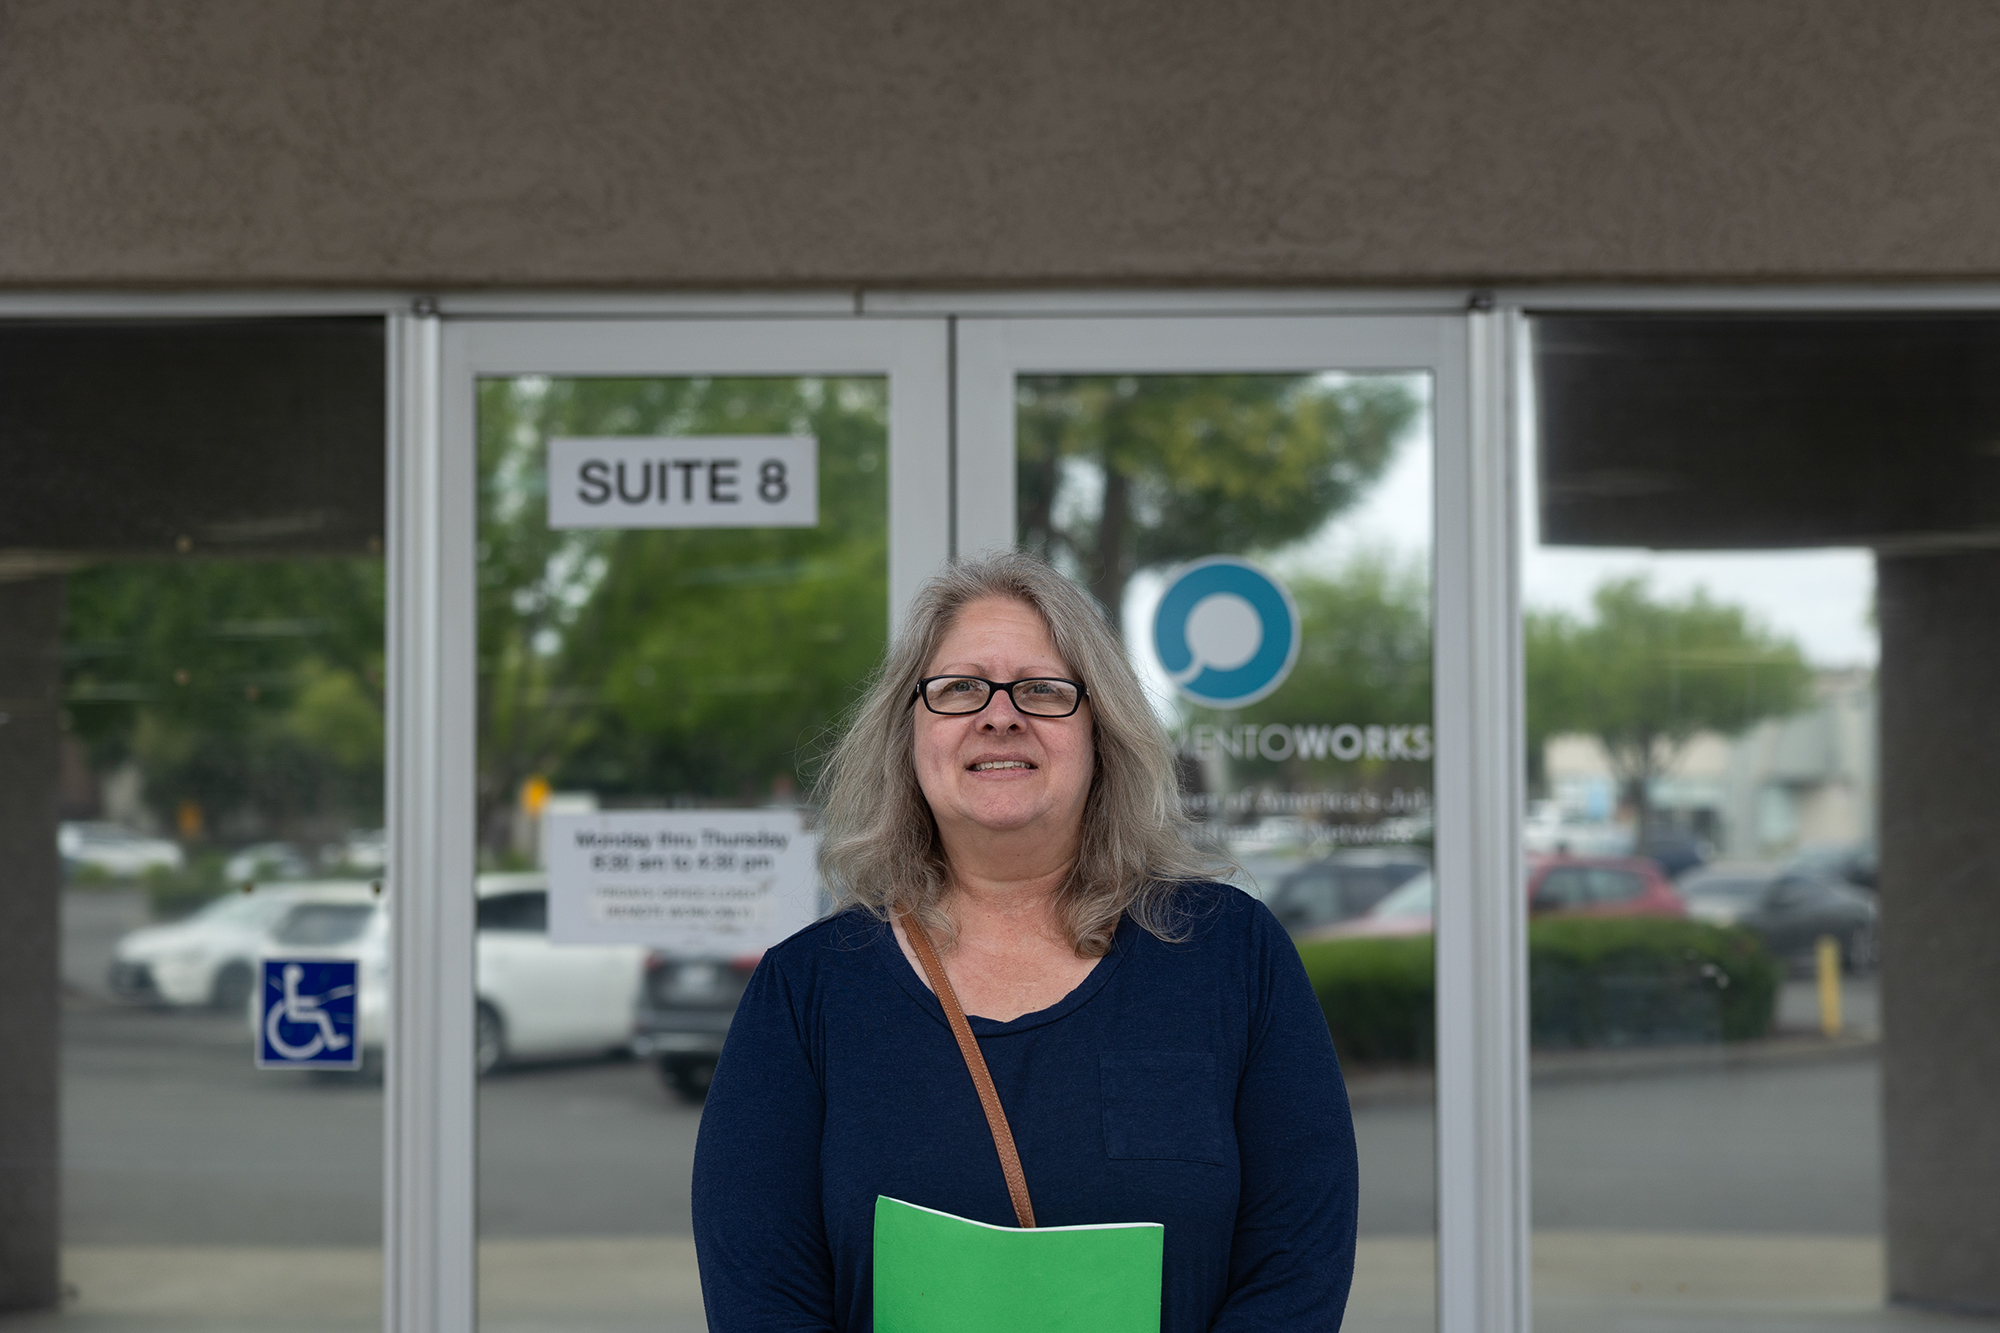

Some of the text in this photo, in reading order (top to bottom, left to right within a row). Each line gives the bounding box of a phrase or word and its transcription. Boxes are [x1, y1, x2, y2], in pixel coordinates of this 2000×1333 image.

[578, 458, 789, 505] SUITE 8
[575, 828, 791, 851] Monday thru Thursday
[638, 857, 666, 872] am
[671, 855, 692, 872] to
[742, 857, 774, 874] pm
